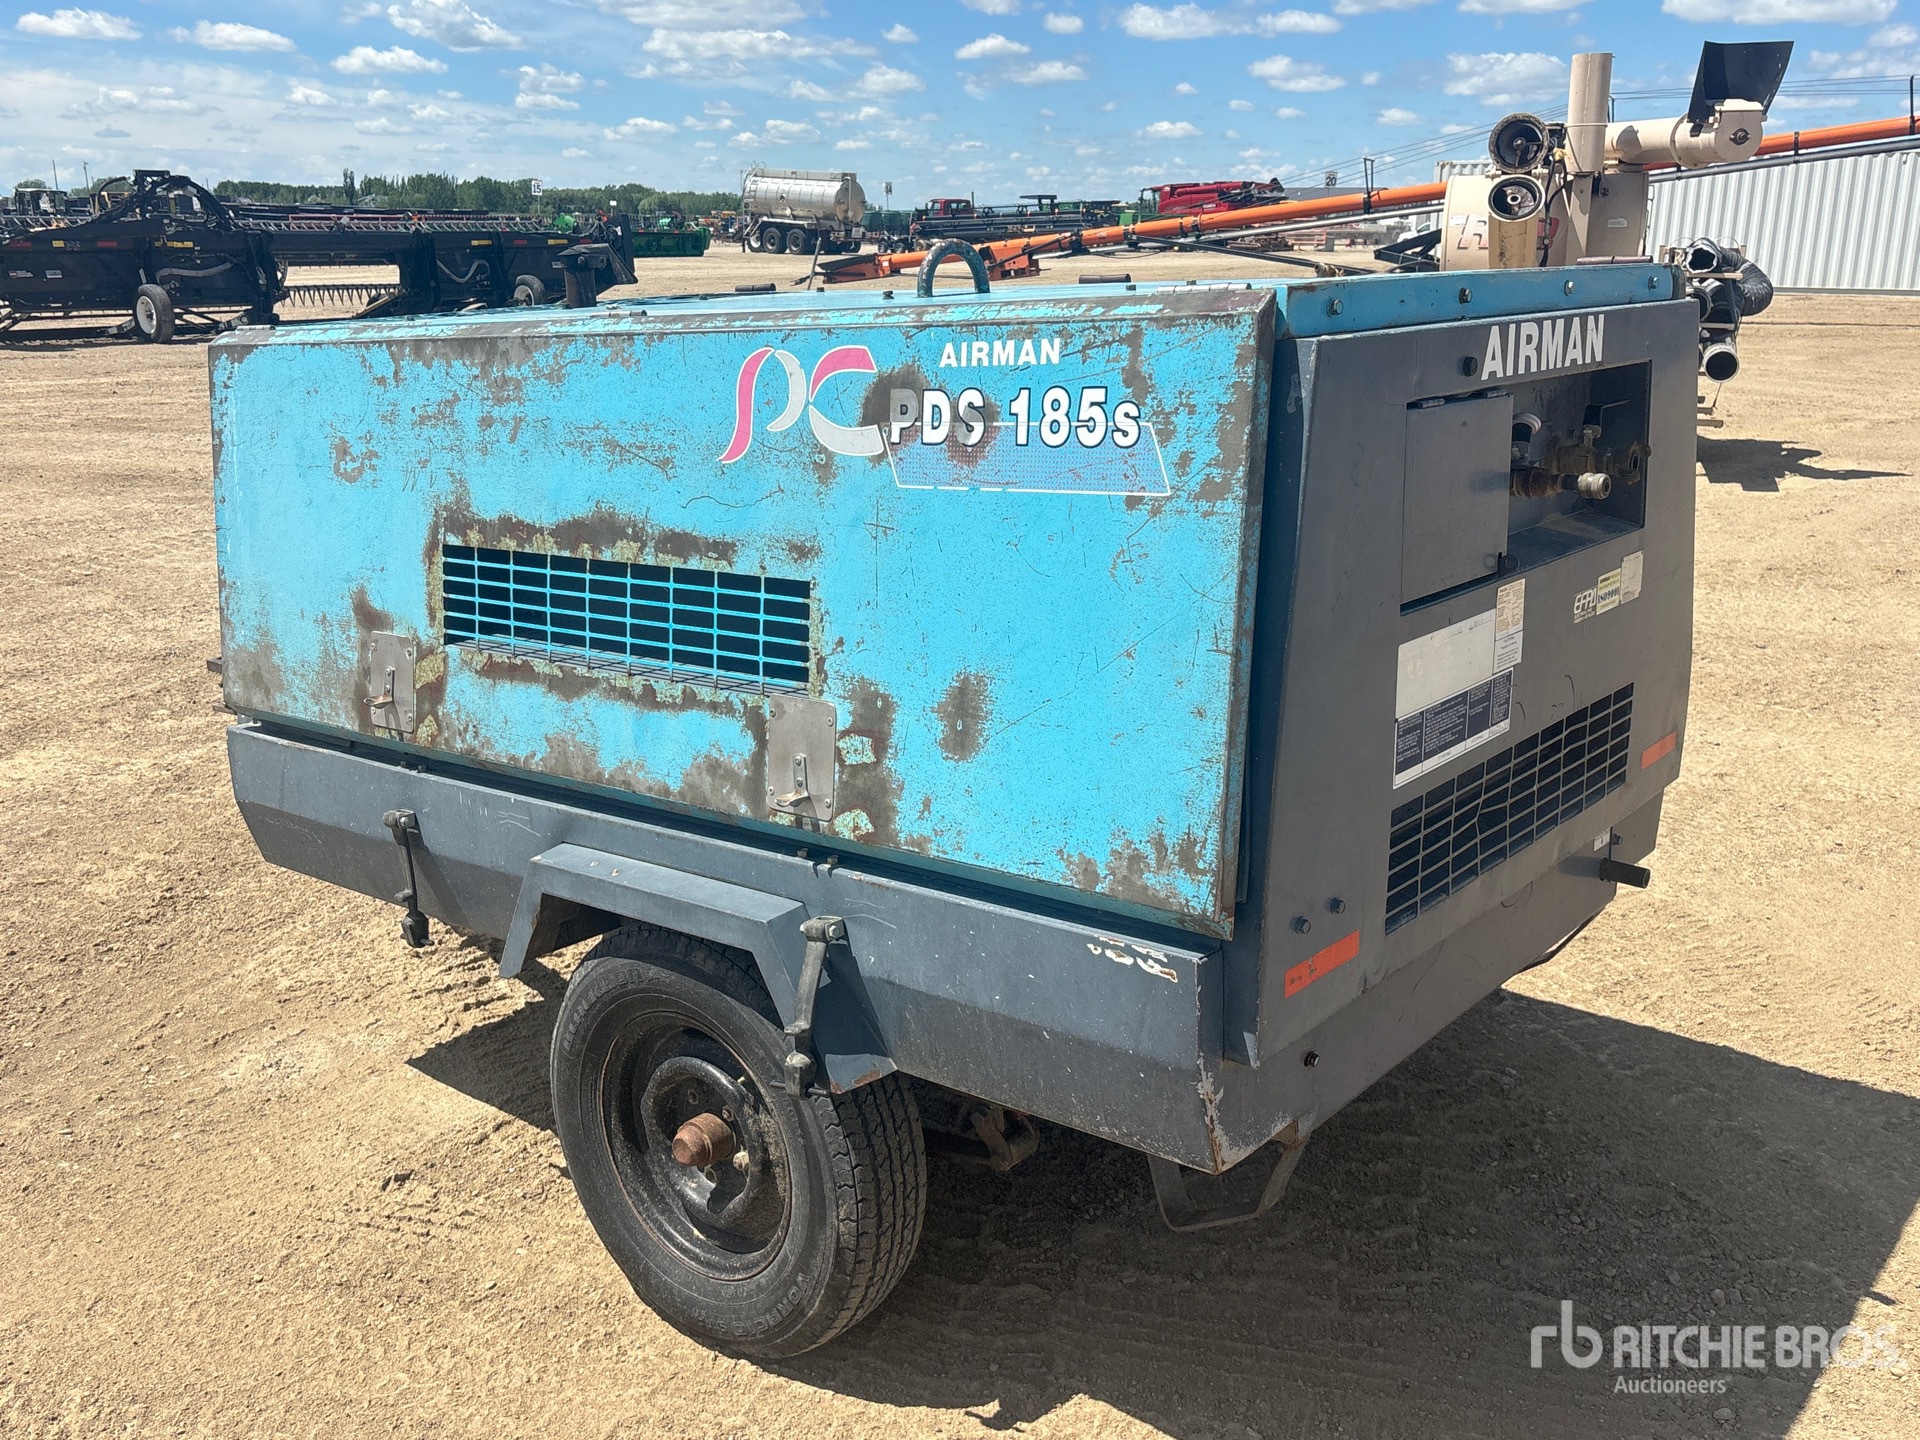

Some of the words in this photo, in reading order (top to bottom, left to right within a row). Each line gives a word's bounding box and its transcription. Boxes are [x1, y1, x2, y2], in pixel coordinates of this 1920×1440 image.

[532, 184, 541, 193] 15
[1325, 176, 1337, 186] 20
[939, 337, 1061, 368] AIRMAN
[1481, 314, 1605, 381] AIRMAN
[889, 387, 985, 447] PDS
[1009, 385, 1142, 448] 185s
